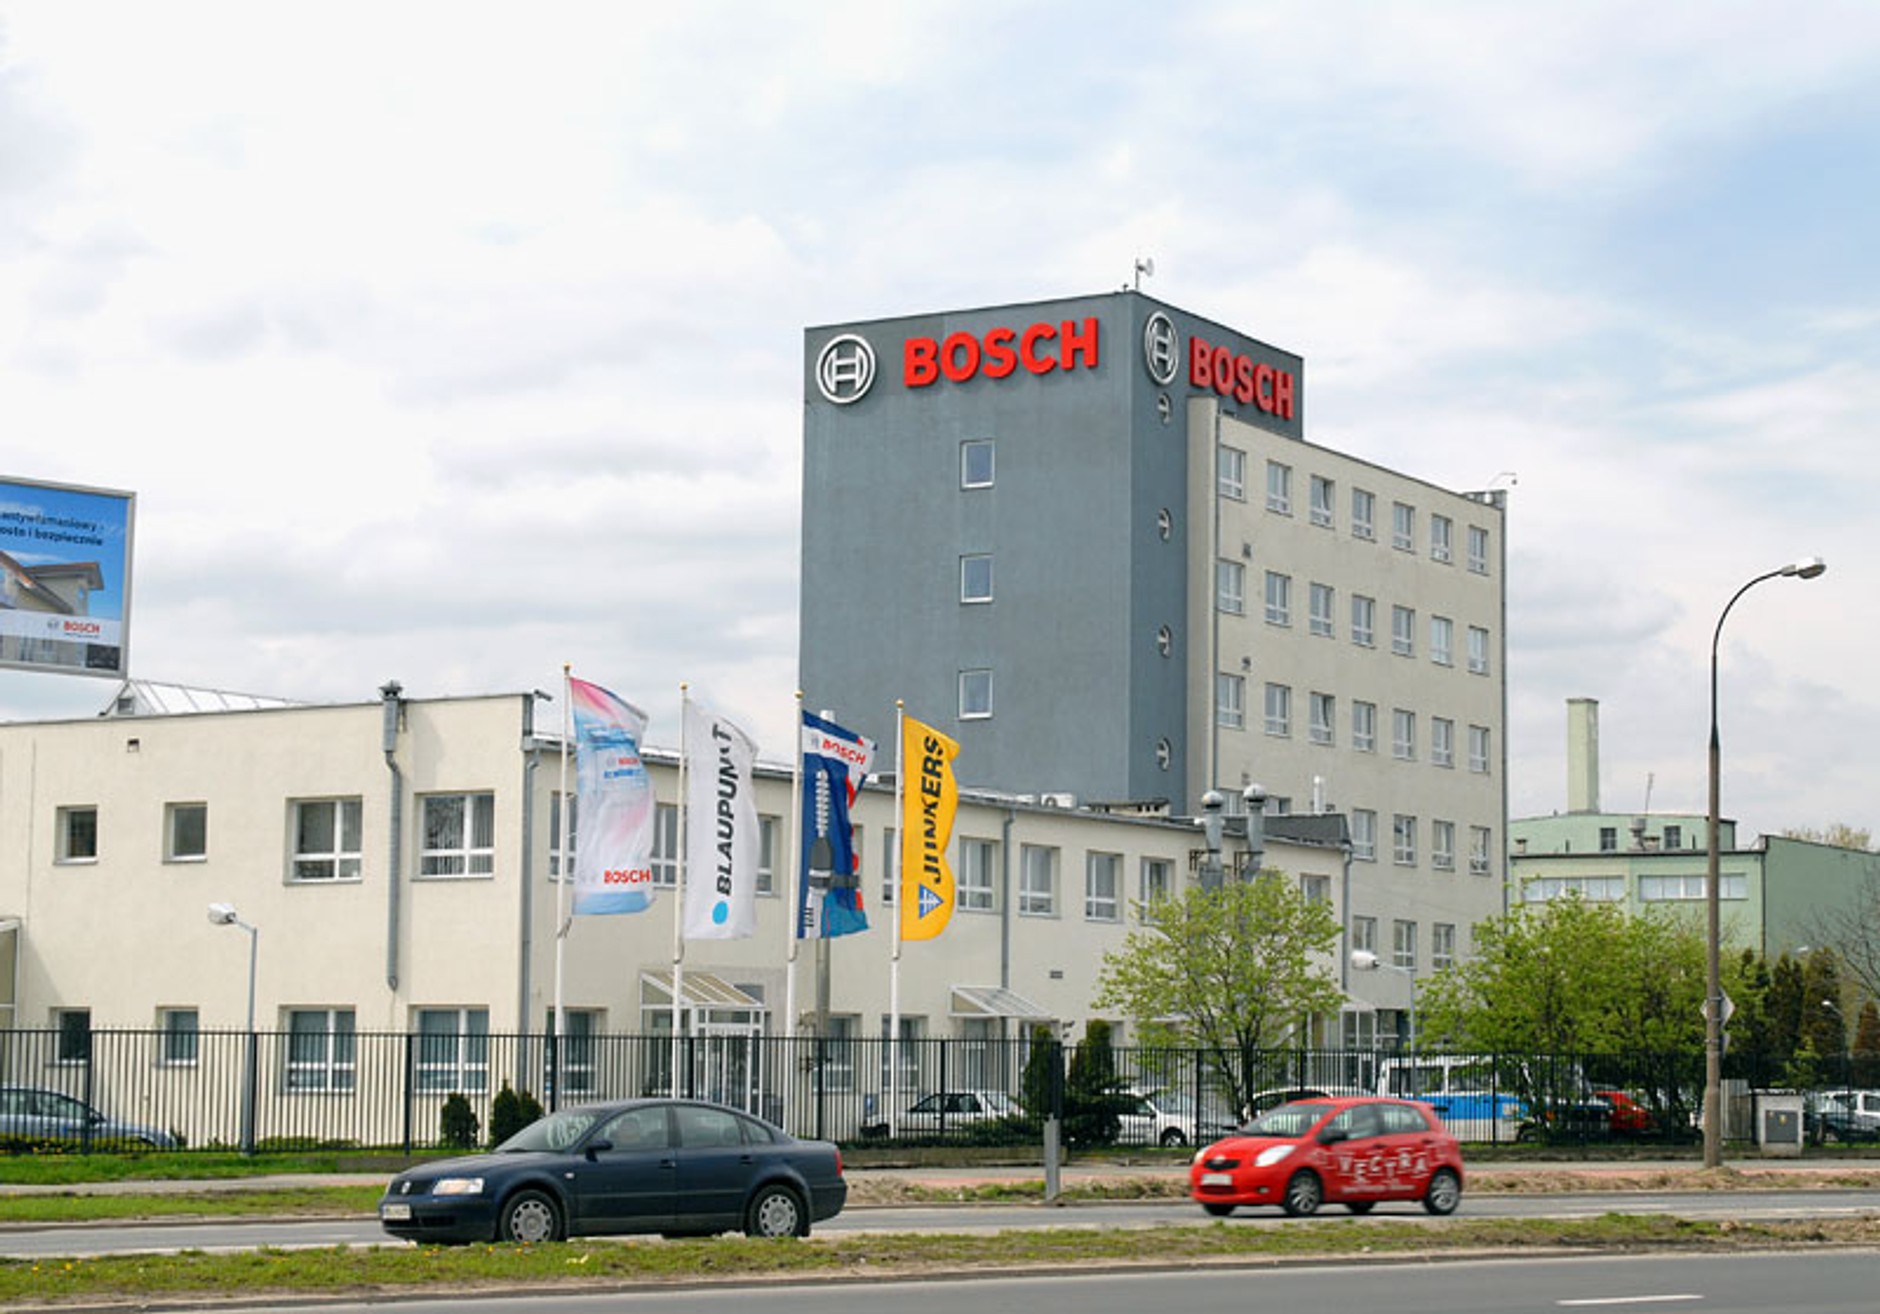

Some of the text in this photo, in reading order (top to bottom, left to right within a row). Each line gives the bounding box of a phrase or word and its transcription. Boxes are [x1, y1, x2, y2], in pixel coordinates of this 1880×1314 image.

[903, 317, 1098, 387] BOSCH
[1189, 336, 1294, 420] BOSCH
[64, 620, 100, 633] BOSCH
[822, 738, 866, 765] BOSCH
[603, 868, 651, 884] BOSCH
[1339, 1153, 1427, 1182] VECTRA
